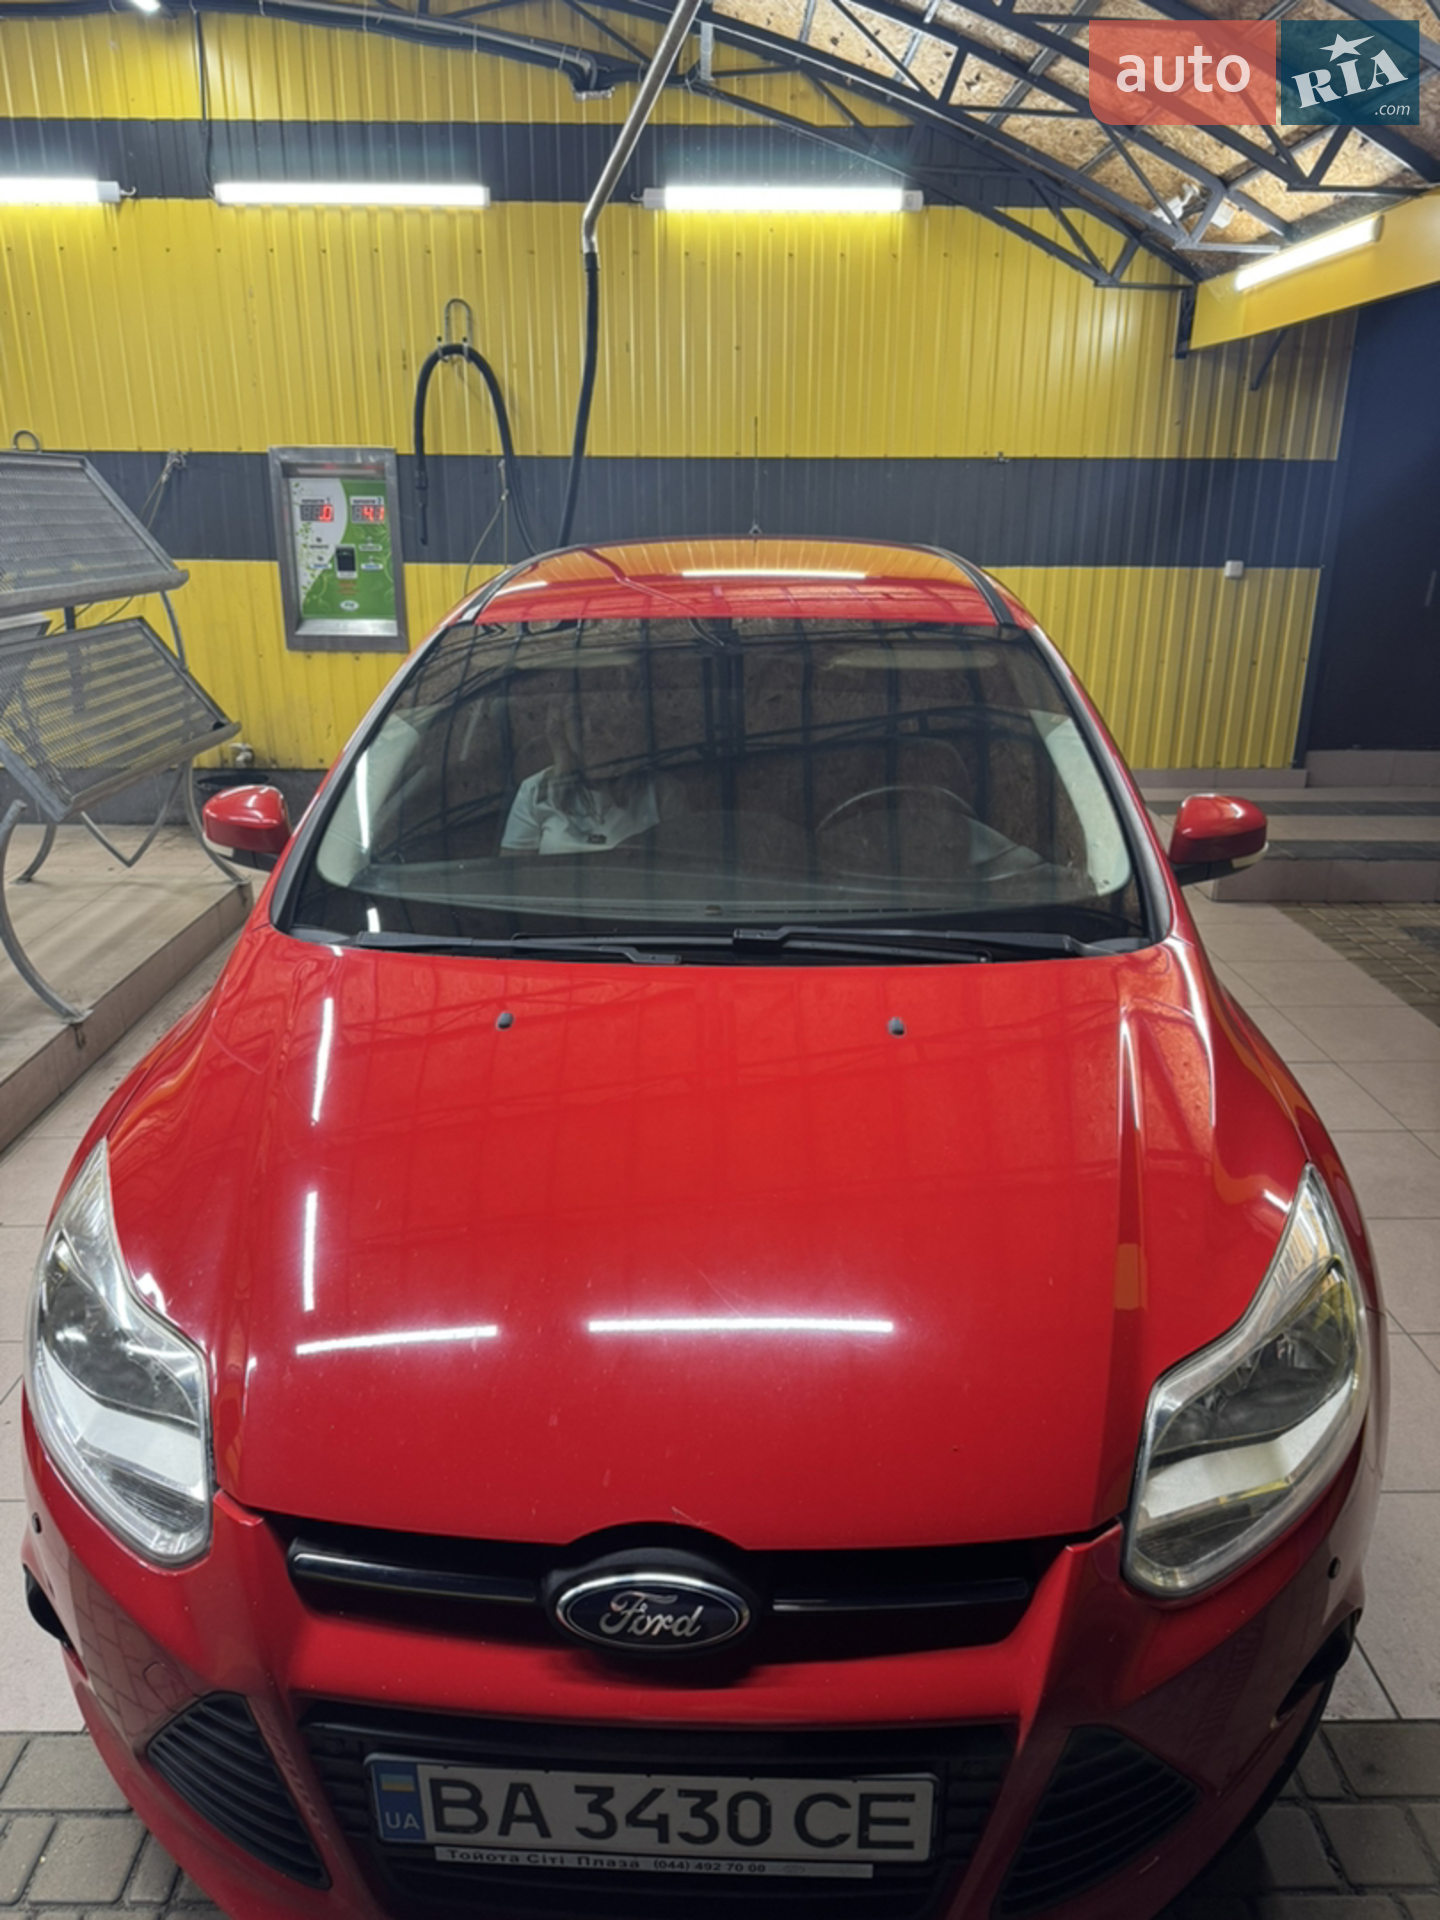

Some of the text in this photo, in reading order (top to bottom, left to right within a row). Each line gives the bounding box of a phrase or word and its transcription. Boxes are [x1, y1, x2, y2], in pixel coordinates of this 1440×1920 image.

[599, 1590, 705, 1638] Ford
[385, 1811, 421, 1832] UA
[429, 1777, 916, 1850] BA 3430 CE
[448, 1849, 520, 1863] Тойота
[526, 1852, 565, 1866] Сіті
[577, 1856, 640, 1869] Плаза
[653, 1859, 690, 1870] (044)
[694, 1861, 721, 1871] 492
[726, 1863, 743, 1872] 70
